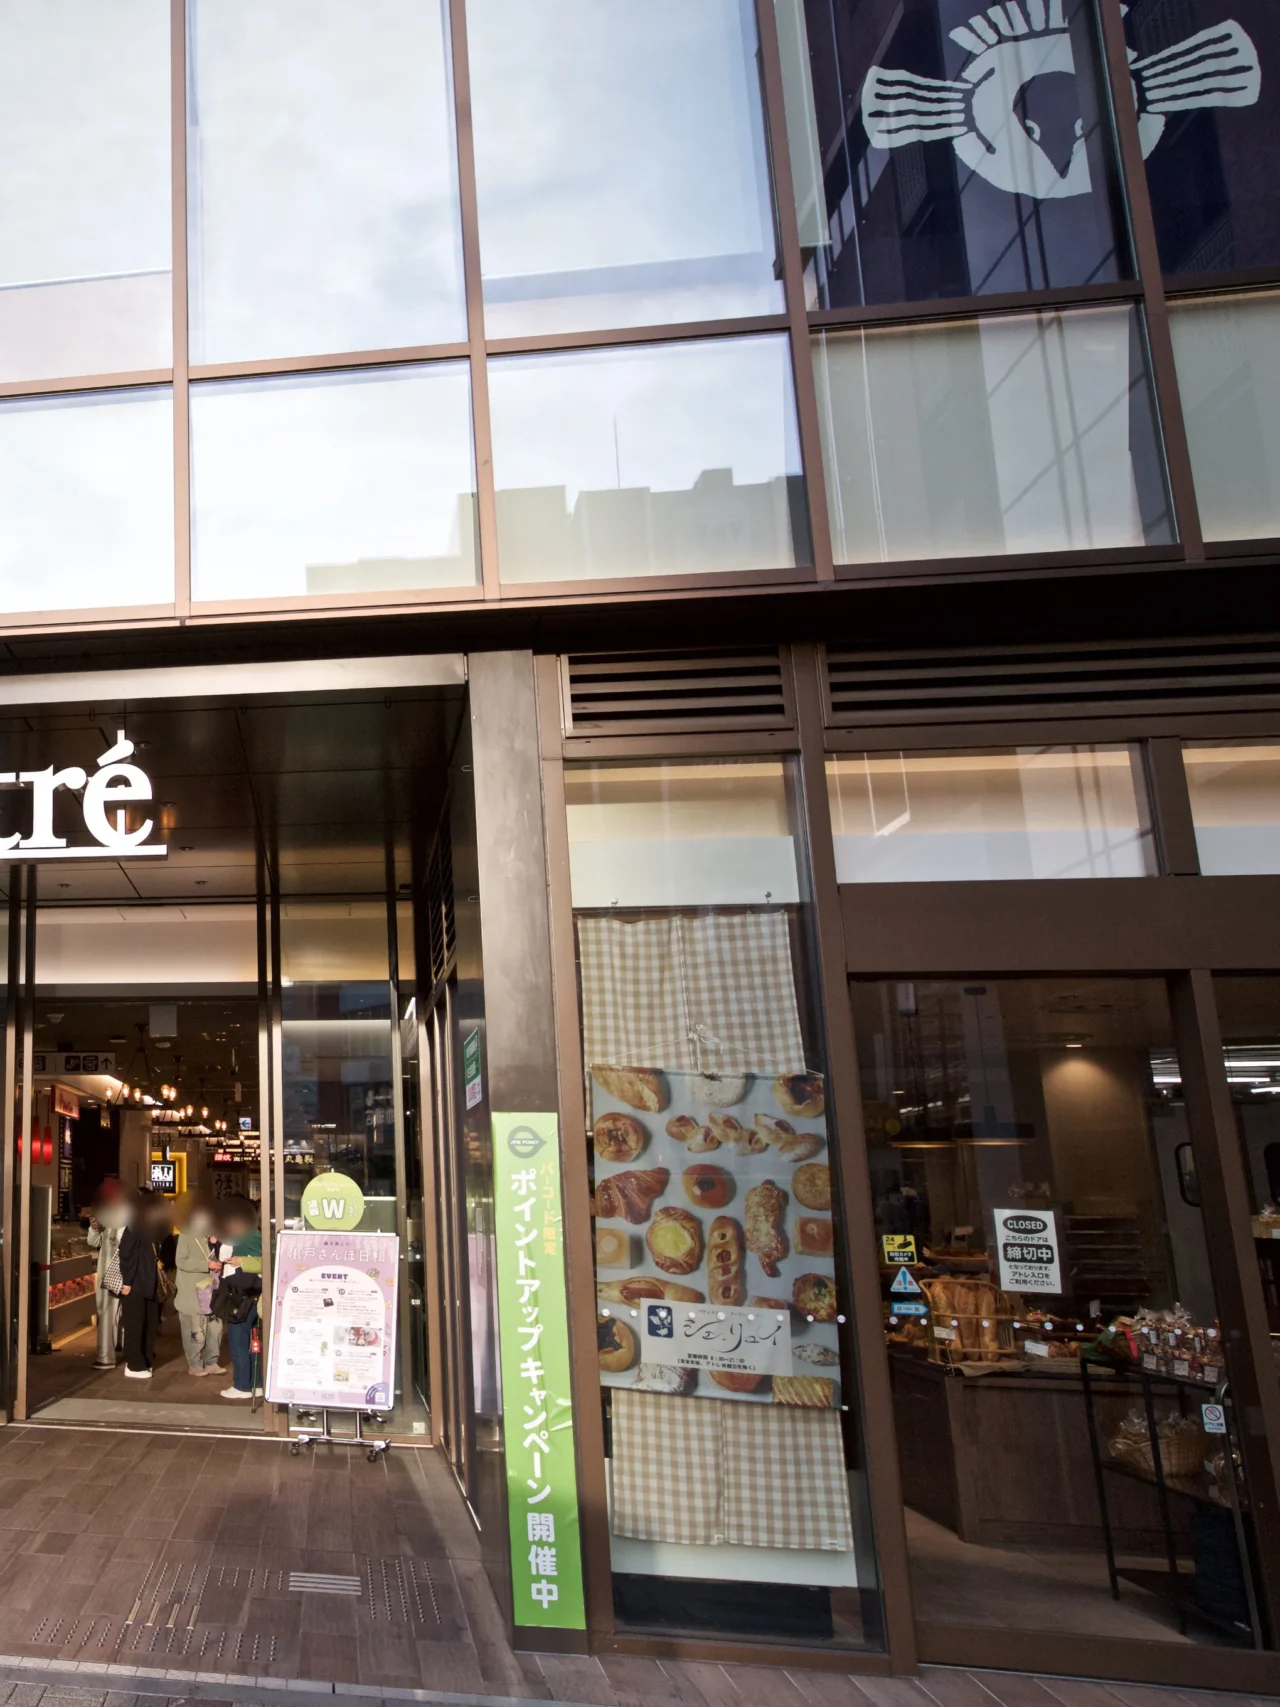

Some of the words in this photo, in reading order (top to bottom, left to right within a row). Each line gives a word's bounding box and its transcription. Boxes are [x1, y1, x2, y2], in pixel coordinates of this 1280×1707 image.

[1007, 1220, 1043, 1229] CLOSED
[1006, 1246, 1052, 1261] 締切中
[1011, 1271, 1050, 1279] アトレ入口を
